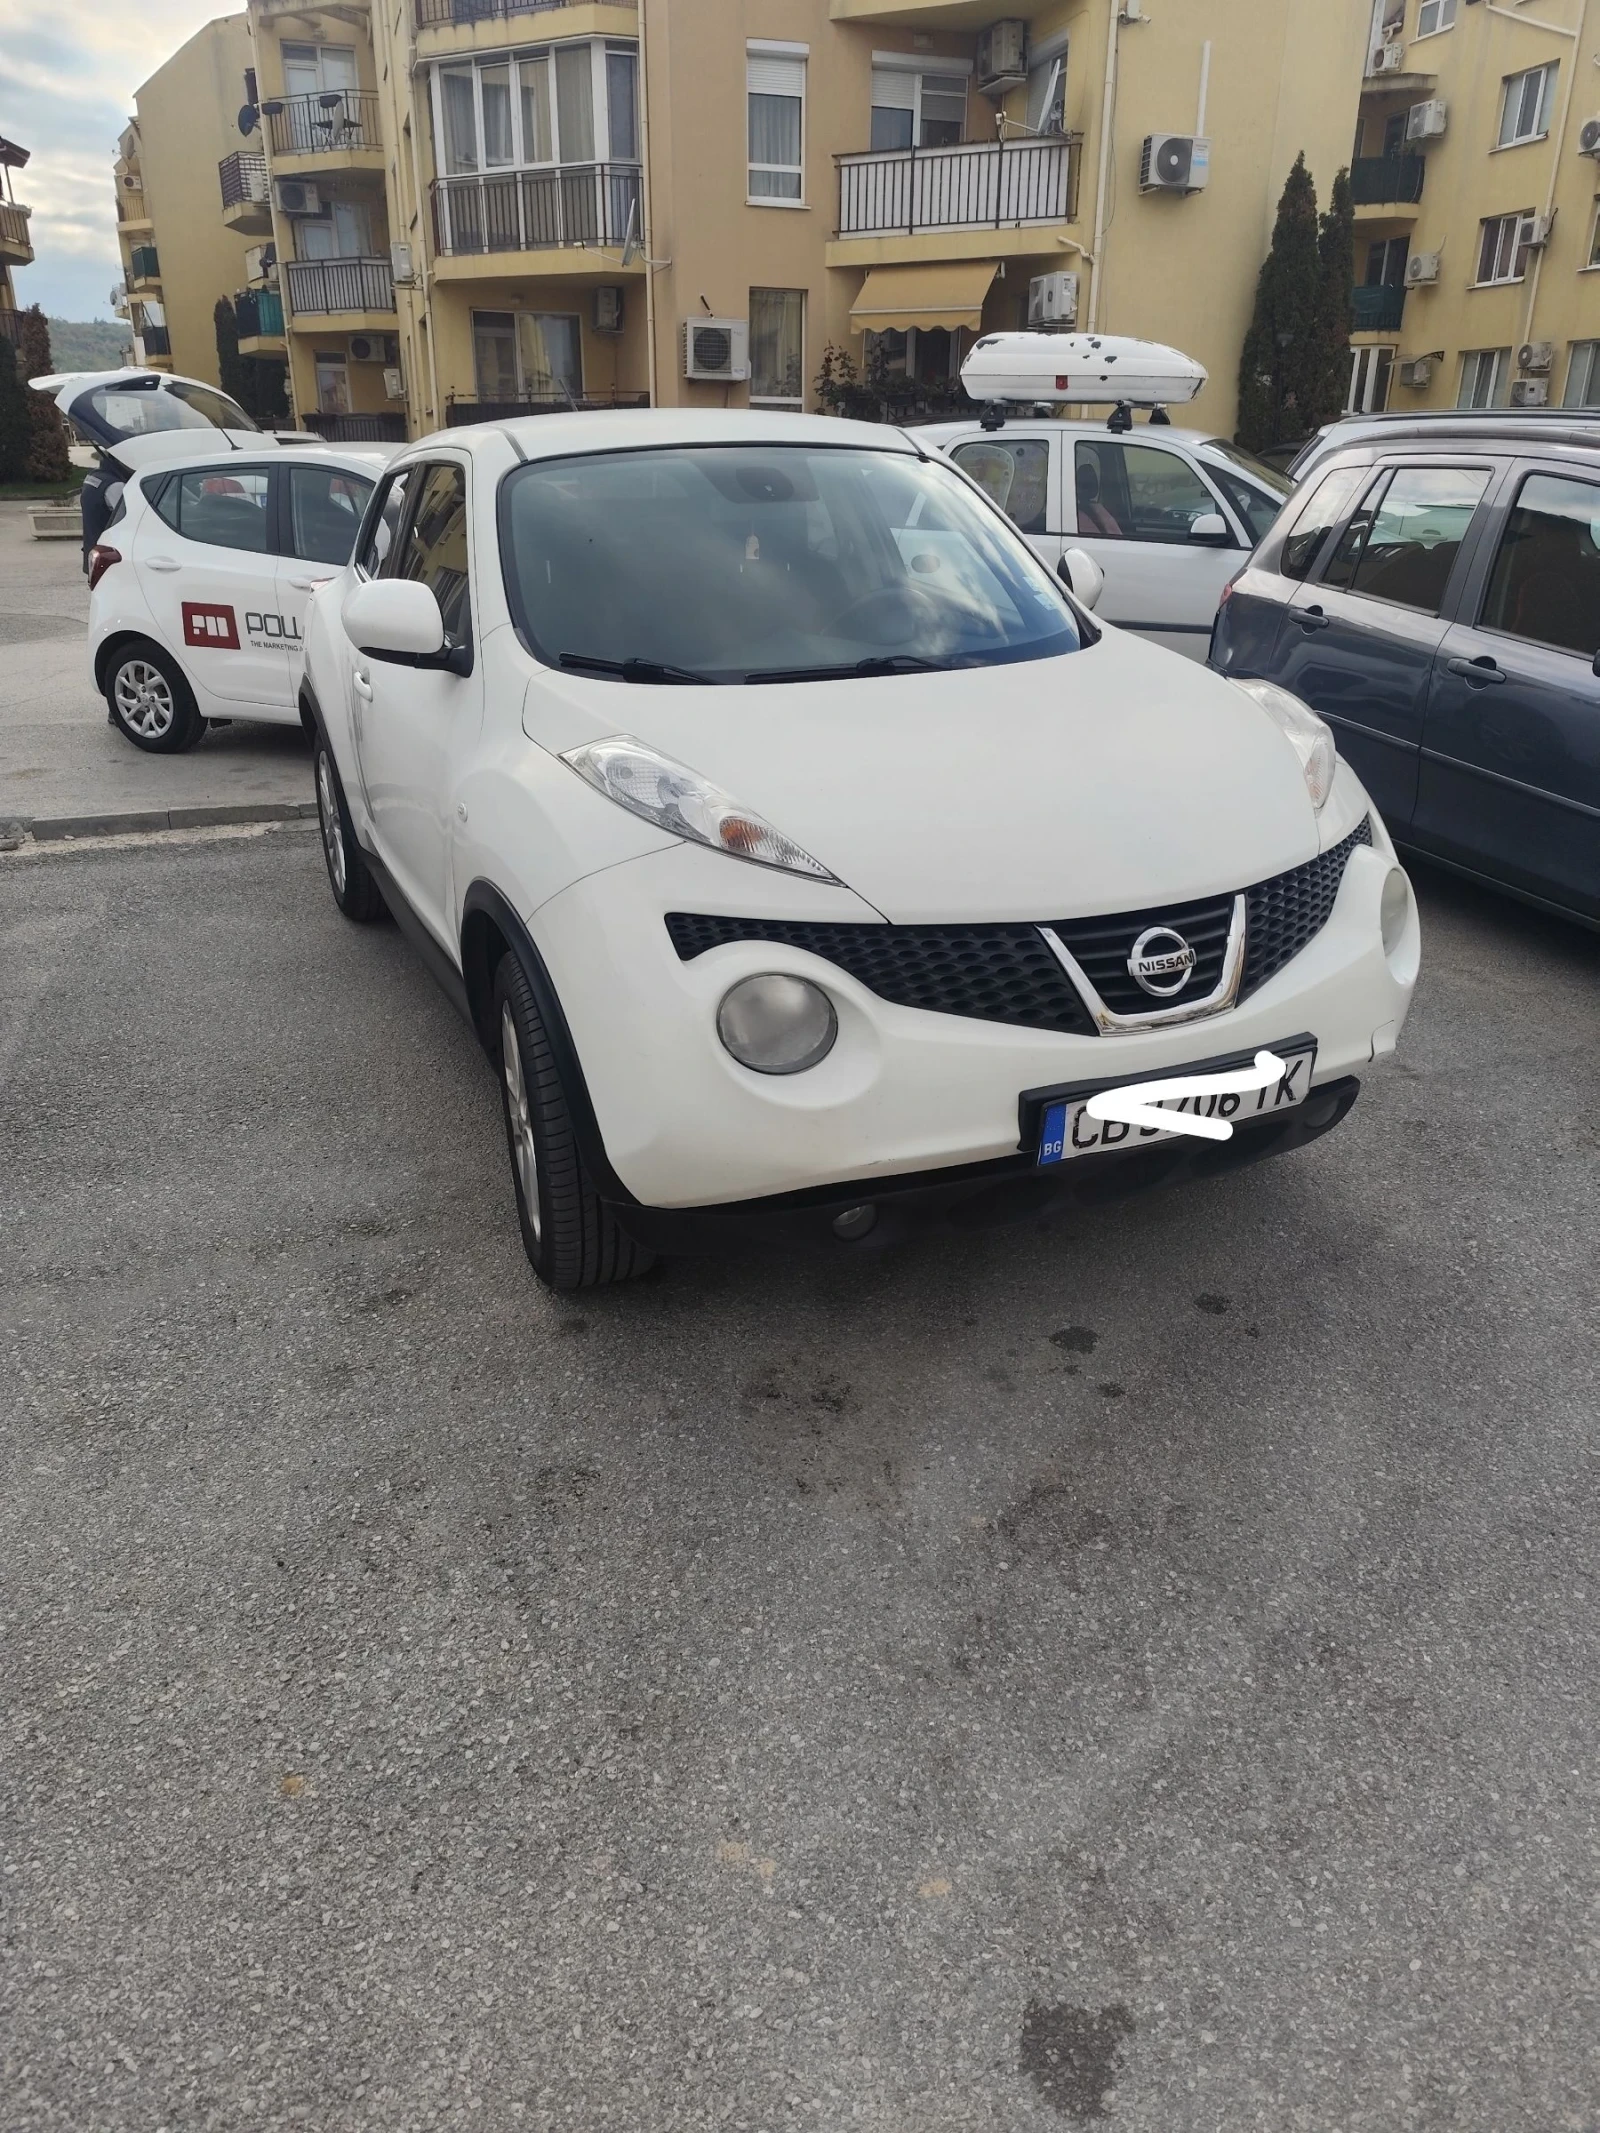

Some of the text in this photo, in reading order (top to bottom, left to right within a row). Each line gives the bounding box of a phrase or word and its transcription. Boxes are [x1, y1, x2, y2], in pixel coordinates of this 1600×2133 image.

[250, 640, 263, 648] THE
[263, 641, 299, 652] MARKETING
[1138, 950, 1194, 973] NISSAN
[1044, 1140, 1062, 1156] BG
